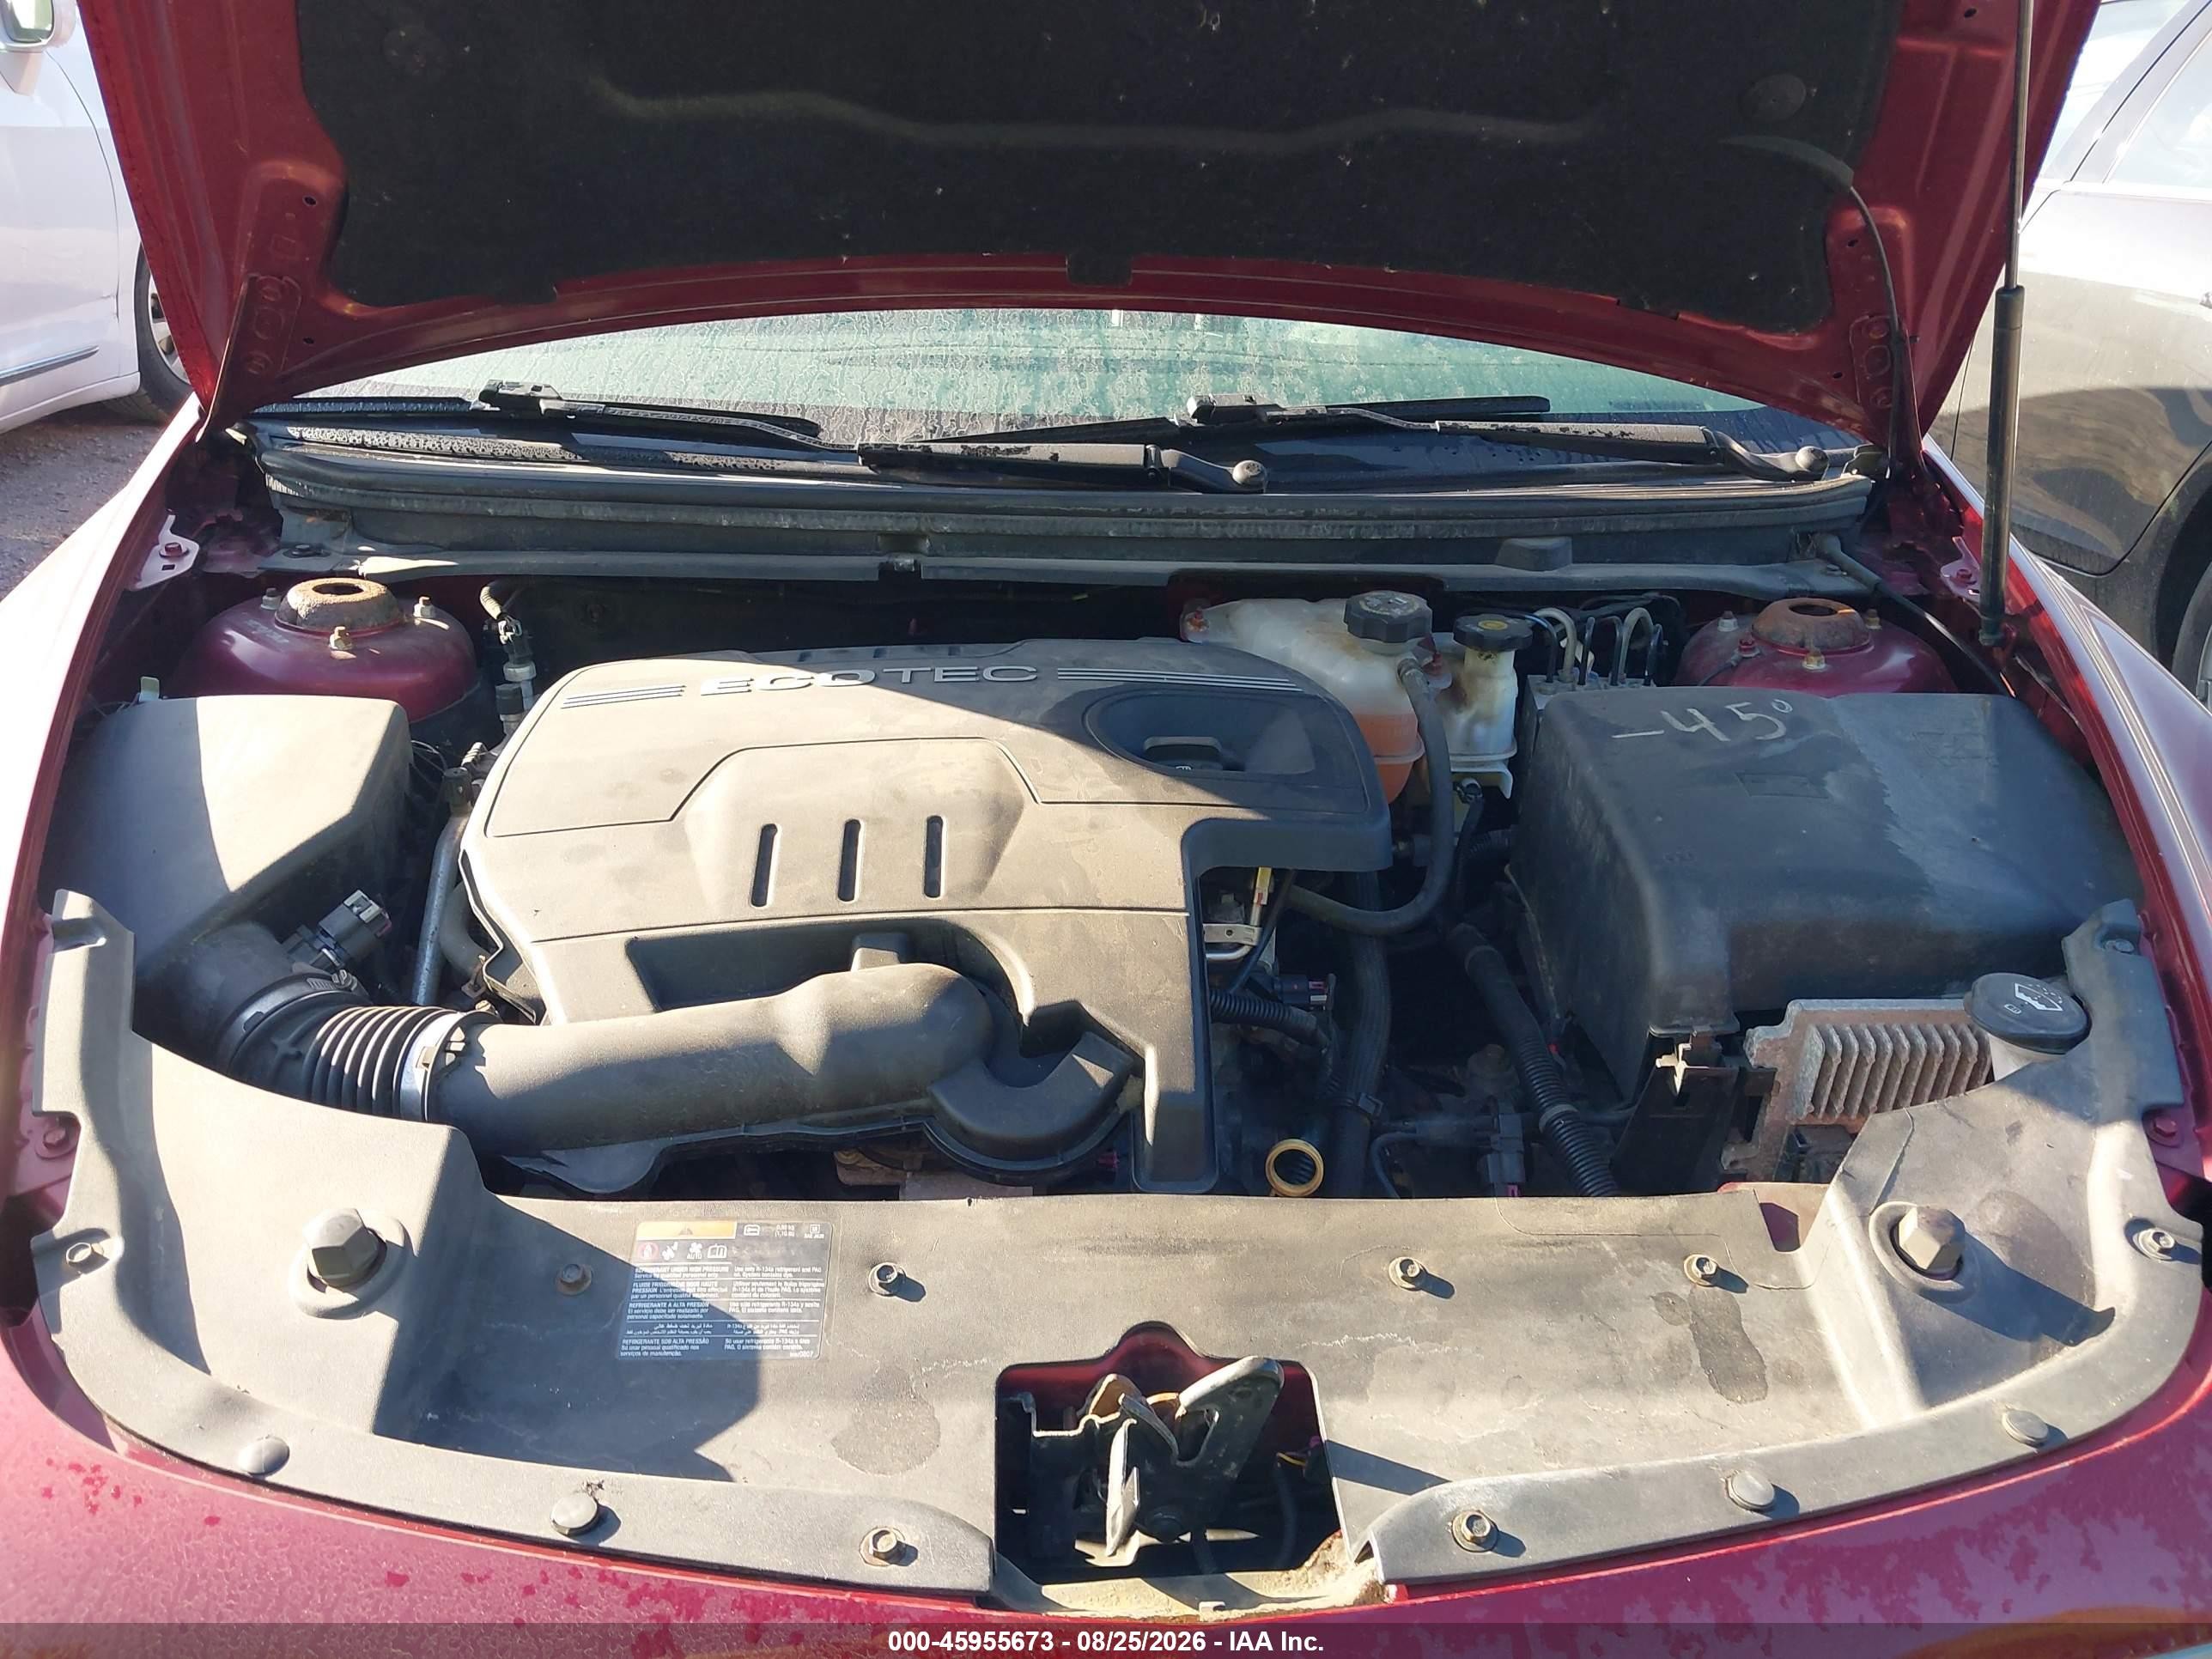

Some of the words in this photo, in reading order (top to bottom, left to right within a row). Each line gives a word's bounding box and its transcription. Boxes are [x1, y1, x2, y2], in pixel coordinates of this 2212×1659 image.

[701, 665, 1037, 696] ECOTEC
[687, 1249, 702, 1260] AUTO
[672, 1337, 685, 1346] ALTA
